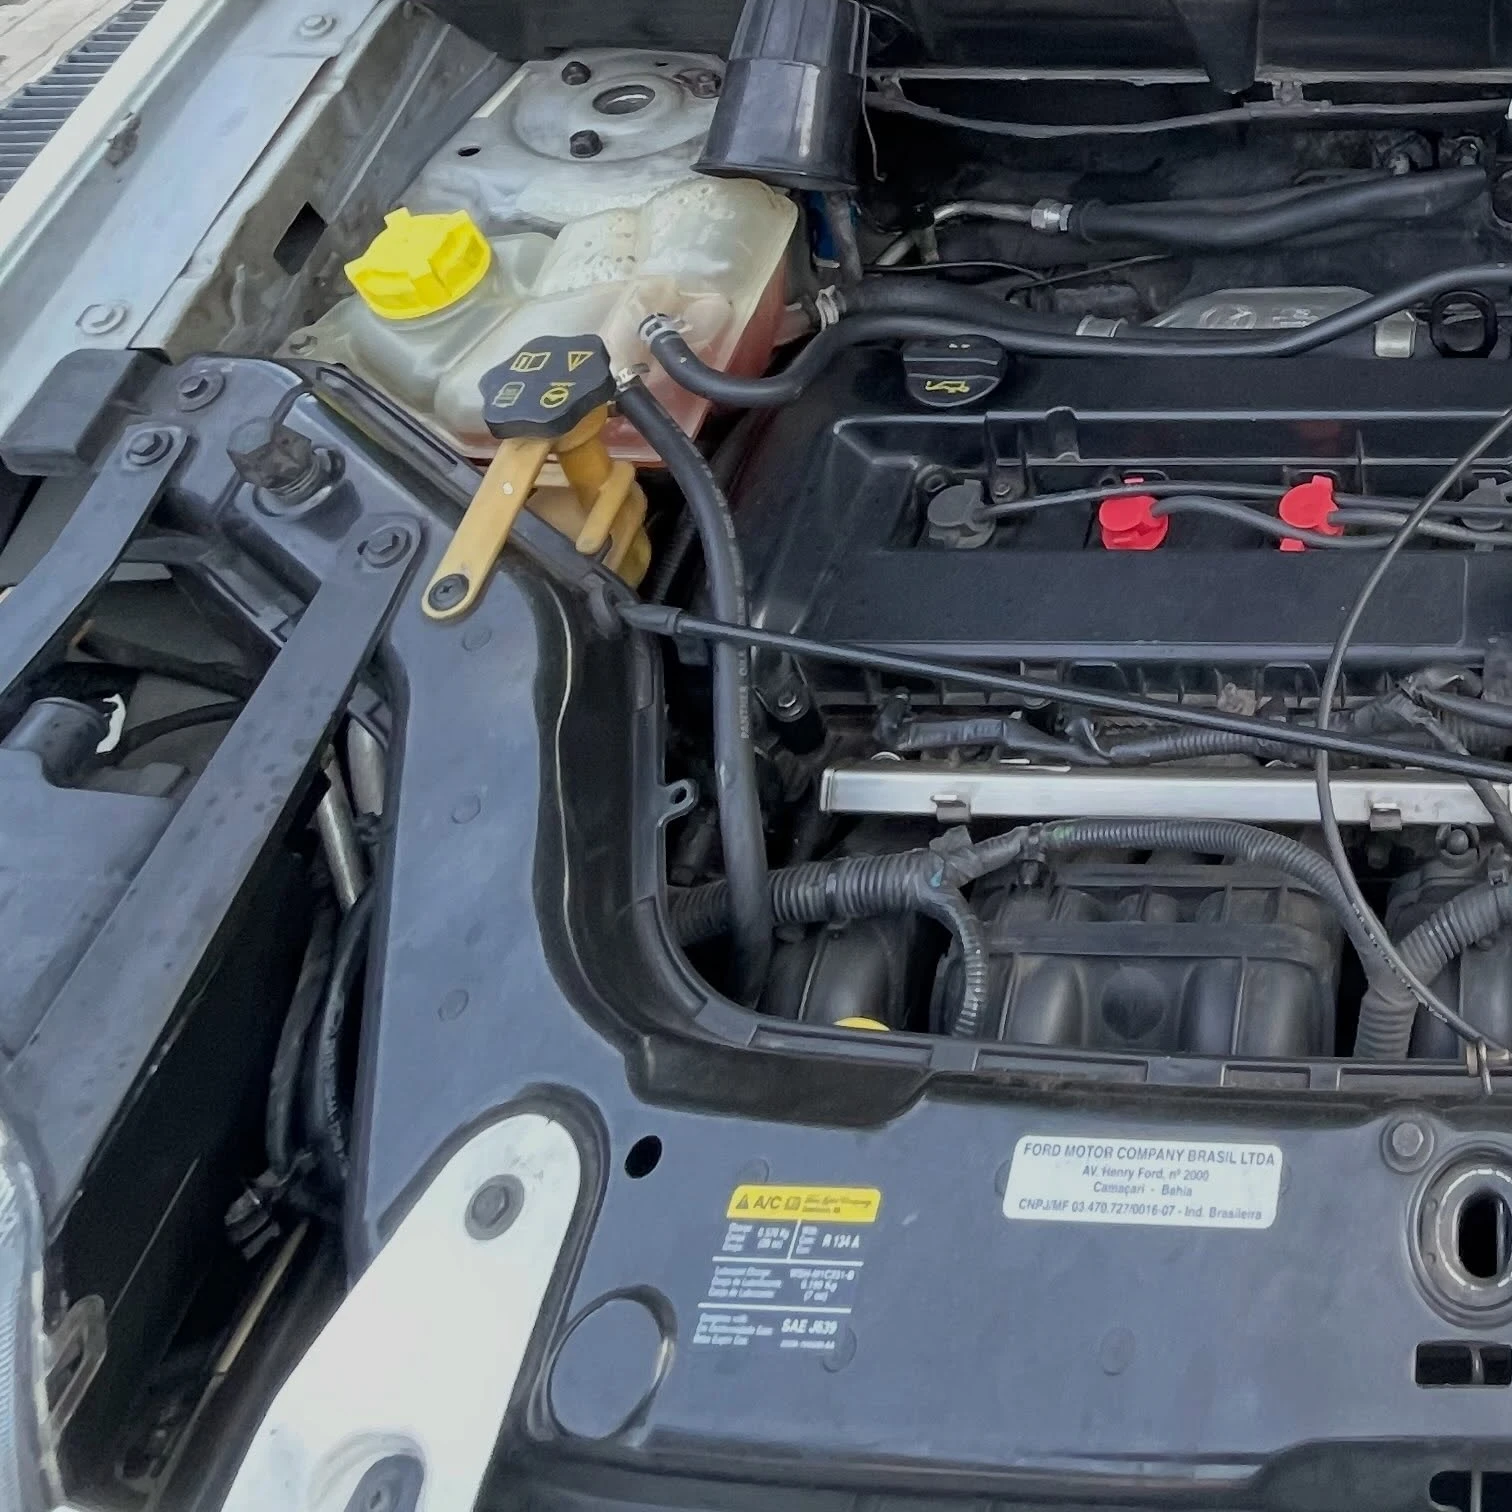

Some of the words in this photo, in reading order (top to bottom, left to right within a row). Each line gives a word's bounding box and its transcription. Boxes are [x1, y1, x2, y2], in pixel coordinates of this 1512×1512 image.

[1023, 1142, 1061, 1157] FORD
[1064, 1144, 1114, 1159] MOTOR
[1116, 1146, 1185, 1162] COMPANY
[1187, 1149, 1237, 1164] BRASIL
[1240, 1151, 1275, 1166] LTDA
[1101, 1167, 1134, 1182] Henry
[1183, 1169, 1210, 1182] 2000
[1161, 1183, 1193, 1197] Bahia
[753, 1195, 781, 1209] A/C
[1208, 1206, 1262, 1220] Brasileira
[780, 1317, 809, 1334] SAE
